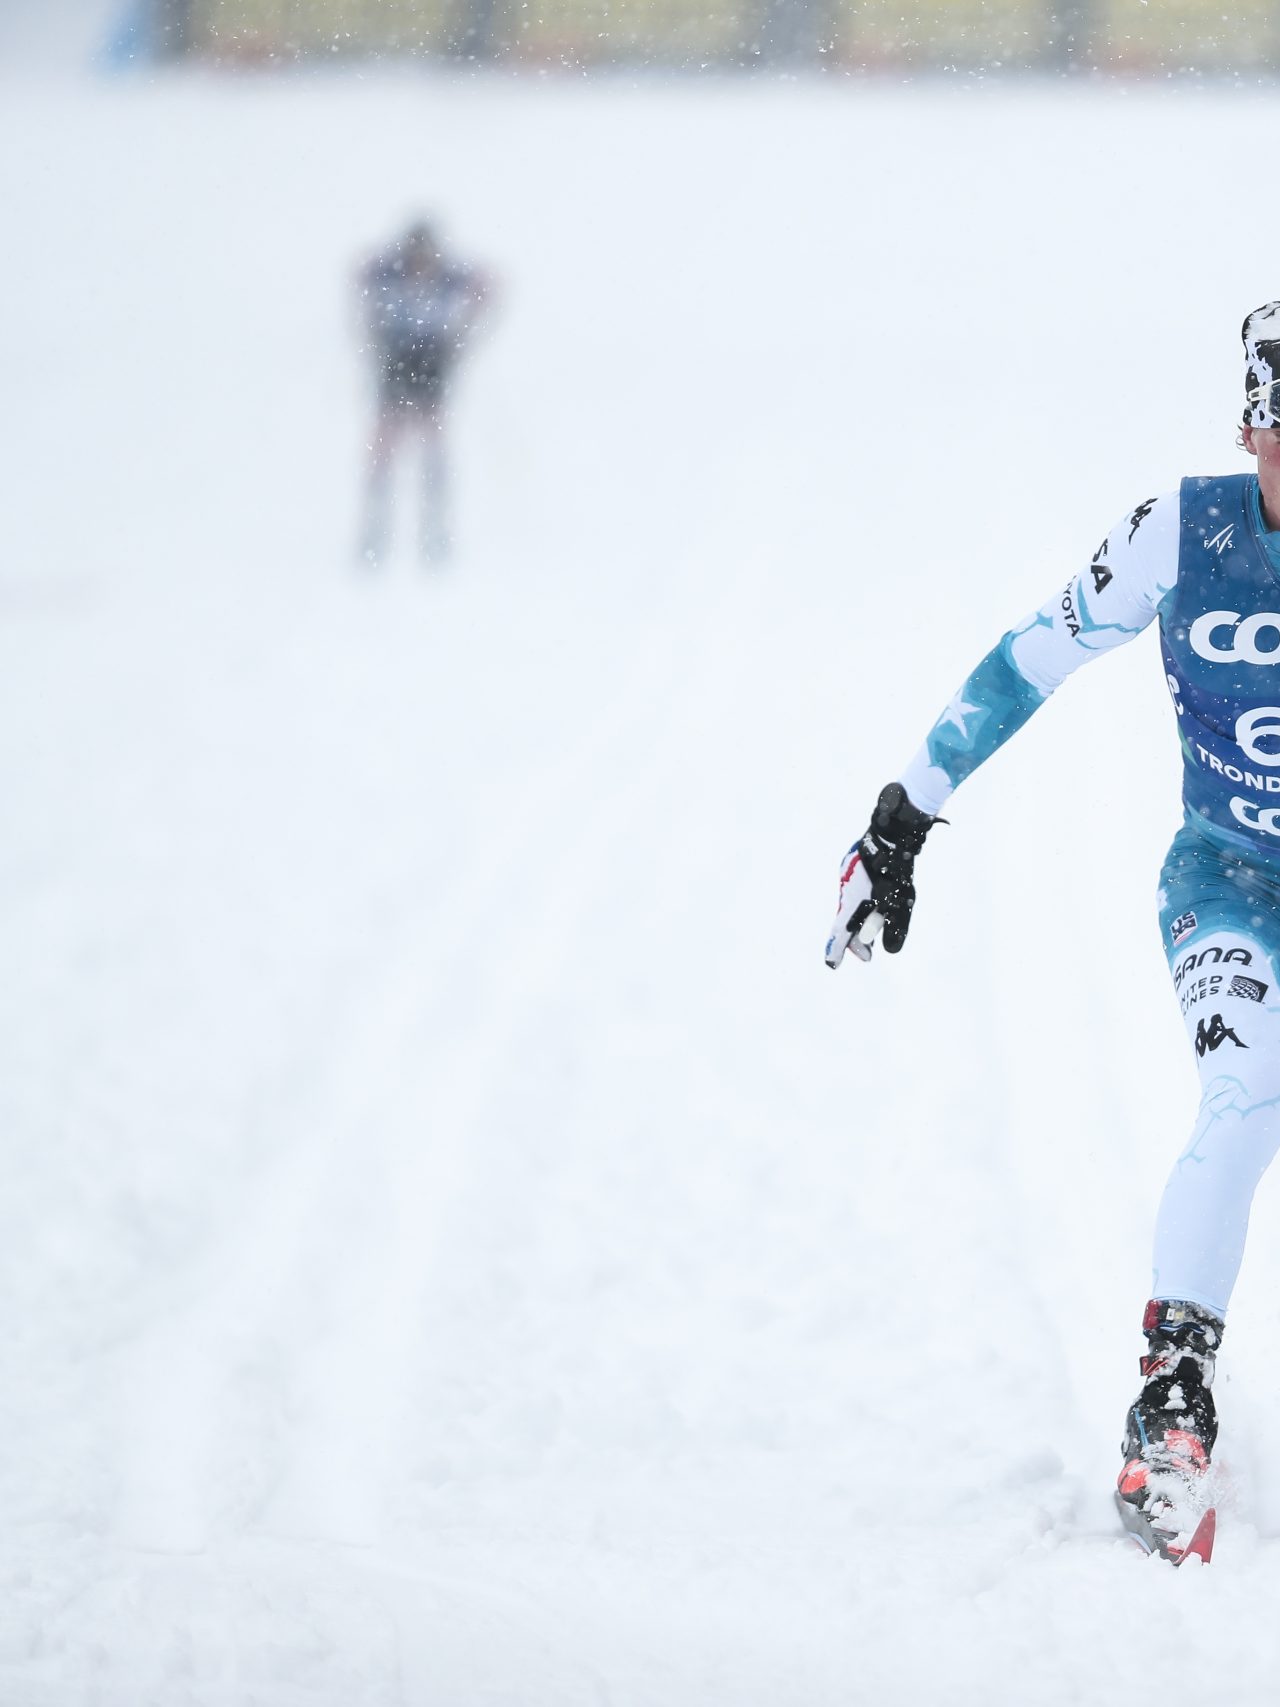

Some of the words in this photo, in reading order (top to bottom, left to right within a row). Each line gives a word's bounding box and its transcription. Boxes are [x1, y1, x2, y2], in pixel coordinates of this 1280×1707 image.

[1174, 946, 1253, 992] SANA
[1181, 975, 1224, 1003] NITED
[1183, 985, 1220, 1016] INES
